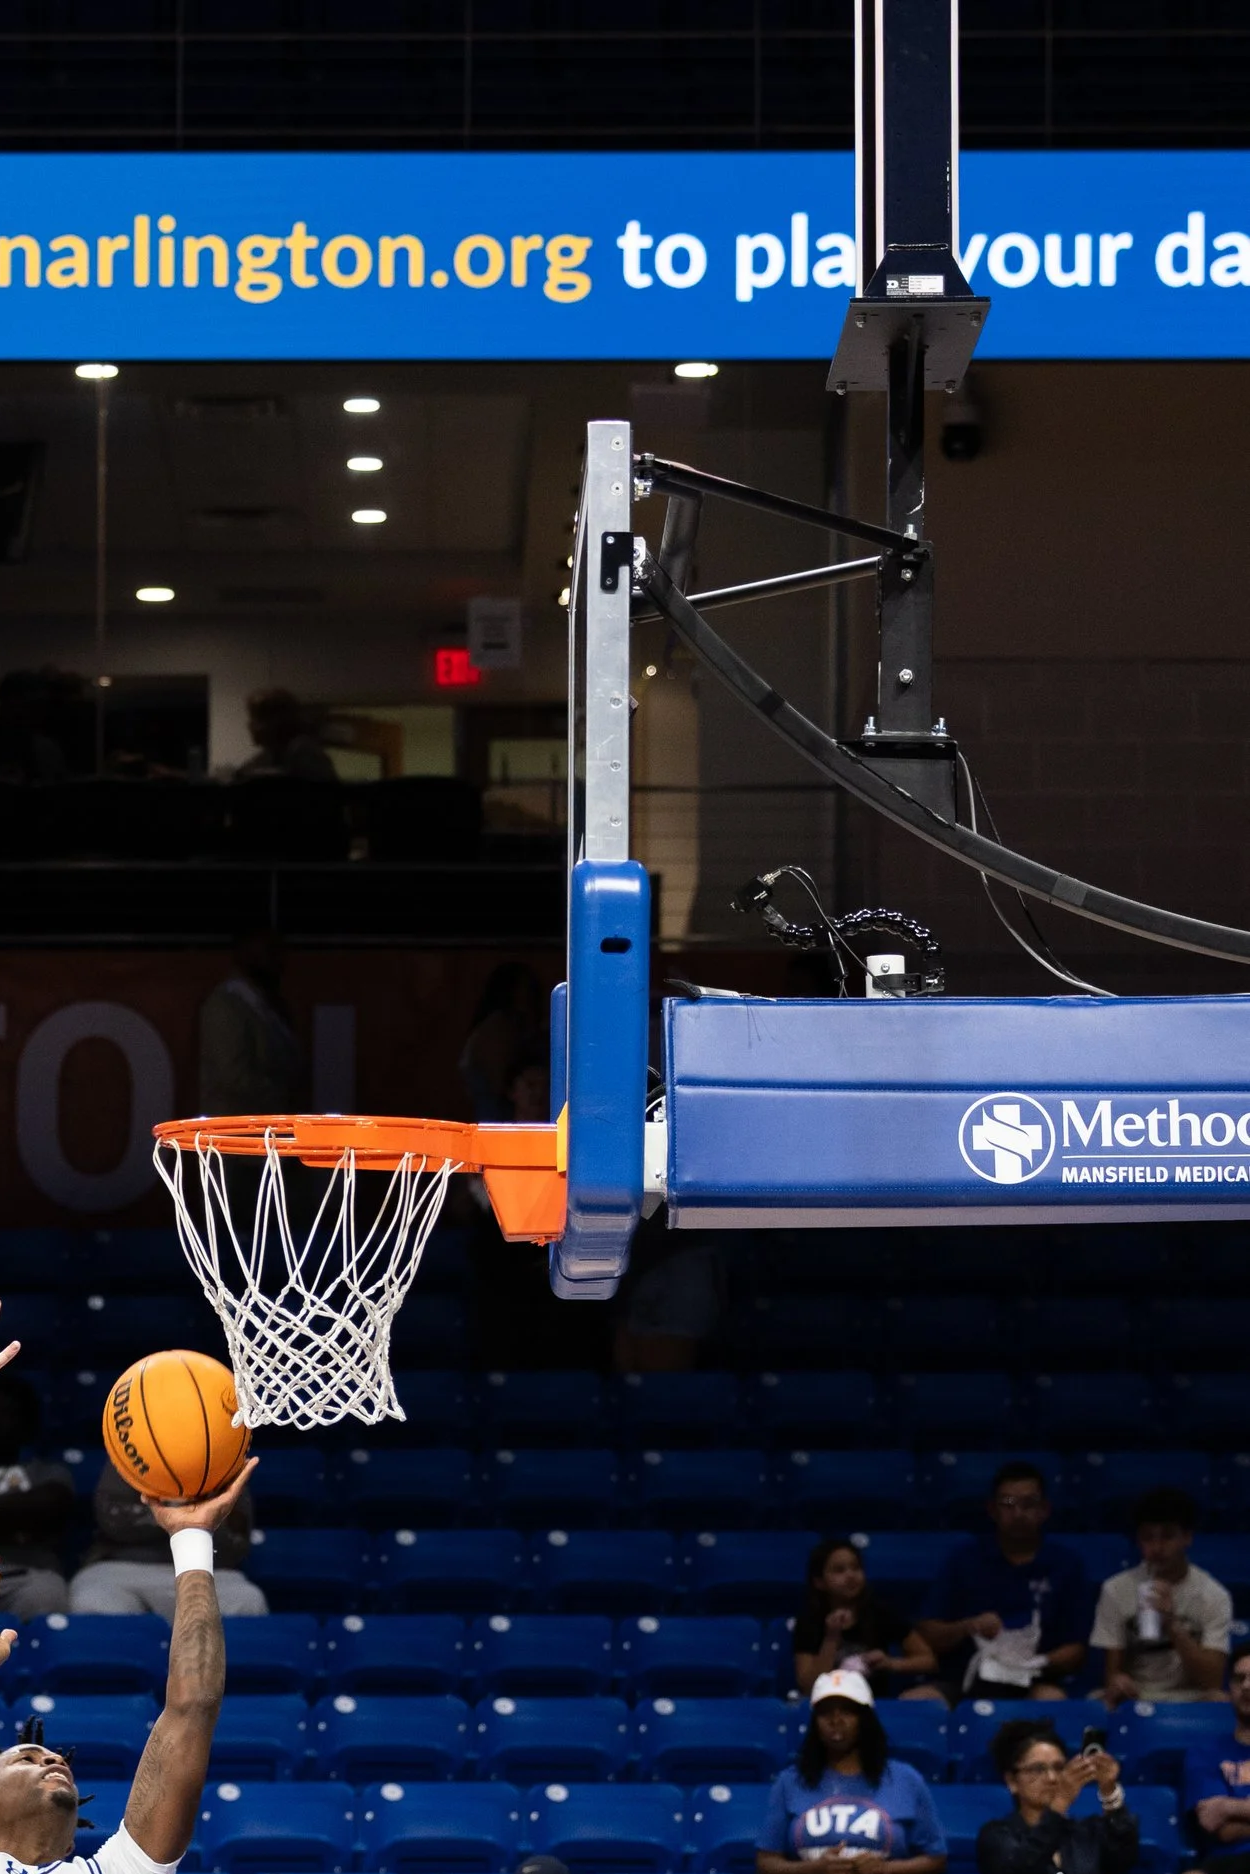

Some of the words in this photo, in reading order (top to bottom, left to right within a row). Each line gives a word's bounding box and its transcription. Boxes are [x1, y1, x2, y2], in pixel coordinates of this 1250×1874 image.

[618, 222, 706, 289] to
[735, 212, 855, 303] pla
[1154, 210, 1250, 288] da
[1061, 1166, 1168, 1184] MANSFIELD
[1175, 1165, 1250, 1183] MEDICA
[113, 1377, 149, 1476] Wilson
[805, 1804, 878, 1840] UTA
